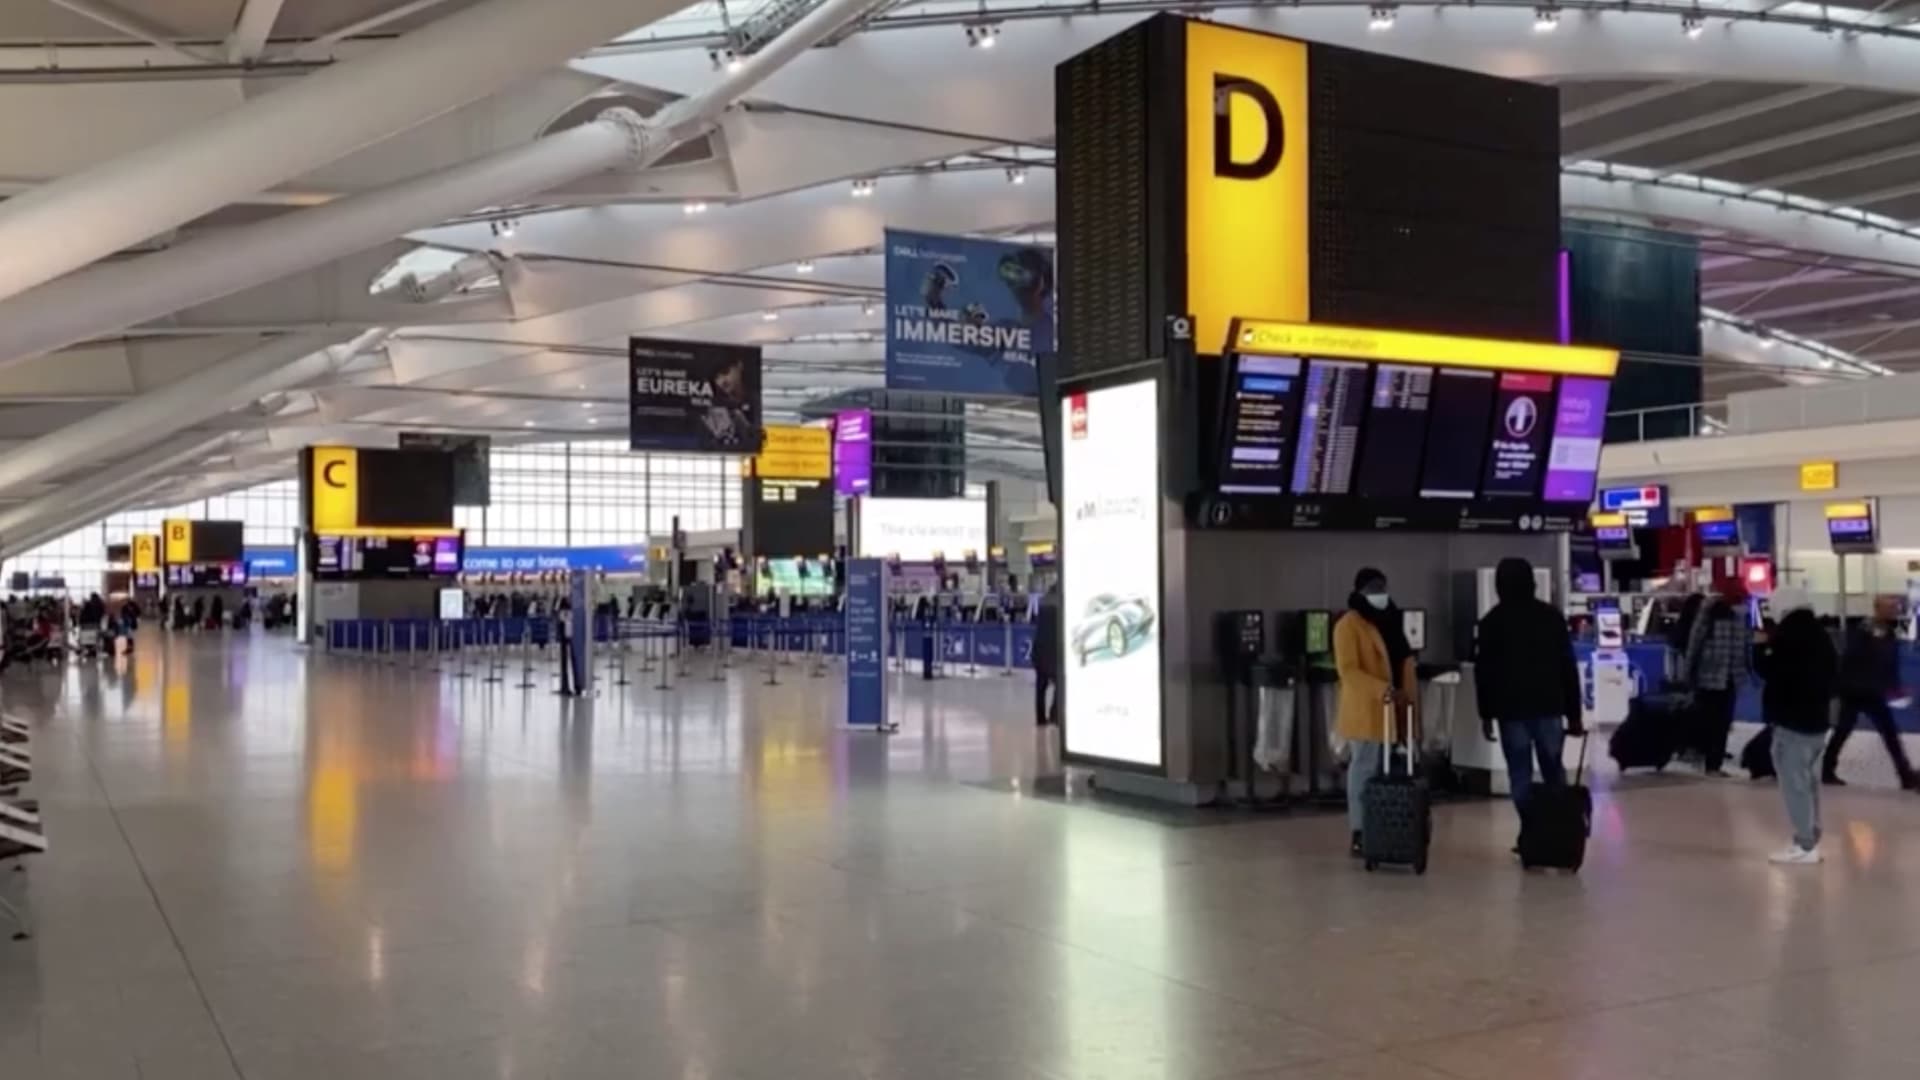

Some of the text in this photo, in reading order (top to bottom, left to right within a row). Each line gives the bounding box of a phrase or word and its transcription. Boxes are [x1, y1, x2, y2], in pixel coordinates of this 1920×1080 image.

[1213, 71, 1286, 182] D
[895, 318, 1031, 350] IMMERSIVE
[637, 377, 714, 398] EUREKA
[323, 459, 347, 489] C
[172, 525, 185, 541] B
[139, 540, 151, 551] A
[501, 556, 514, 569] to
[516, 556, 536, 569] our
[537, 555, 568, 568] home
